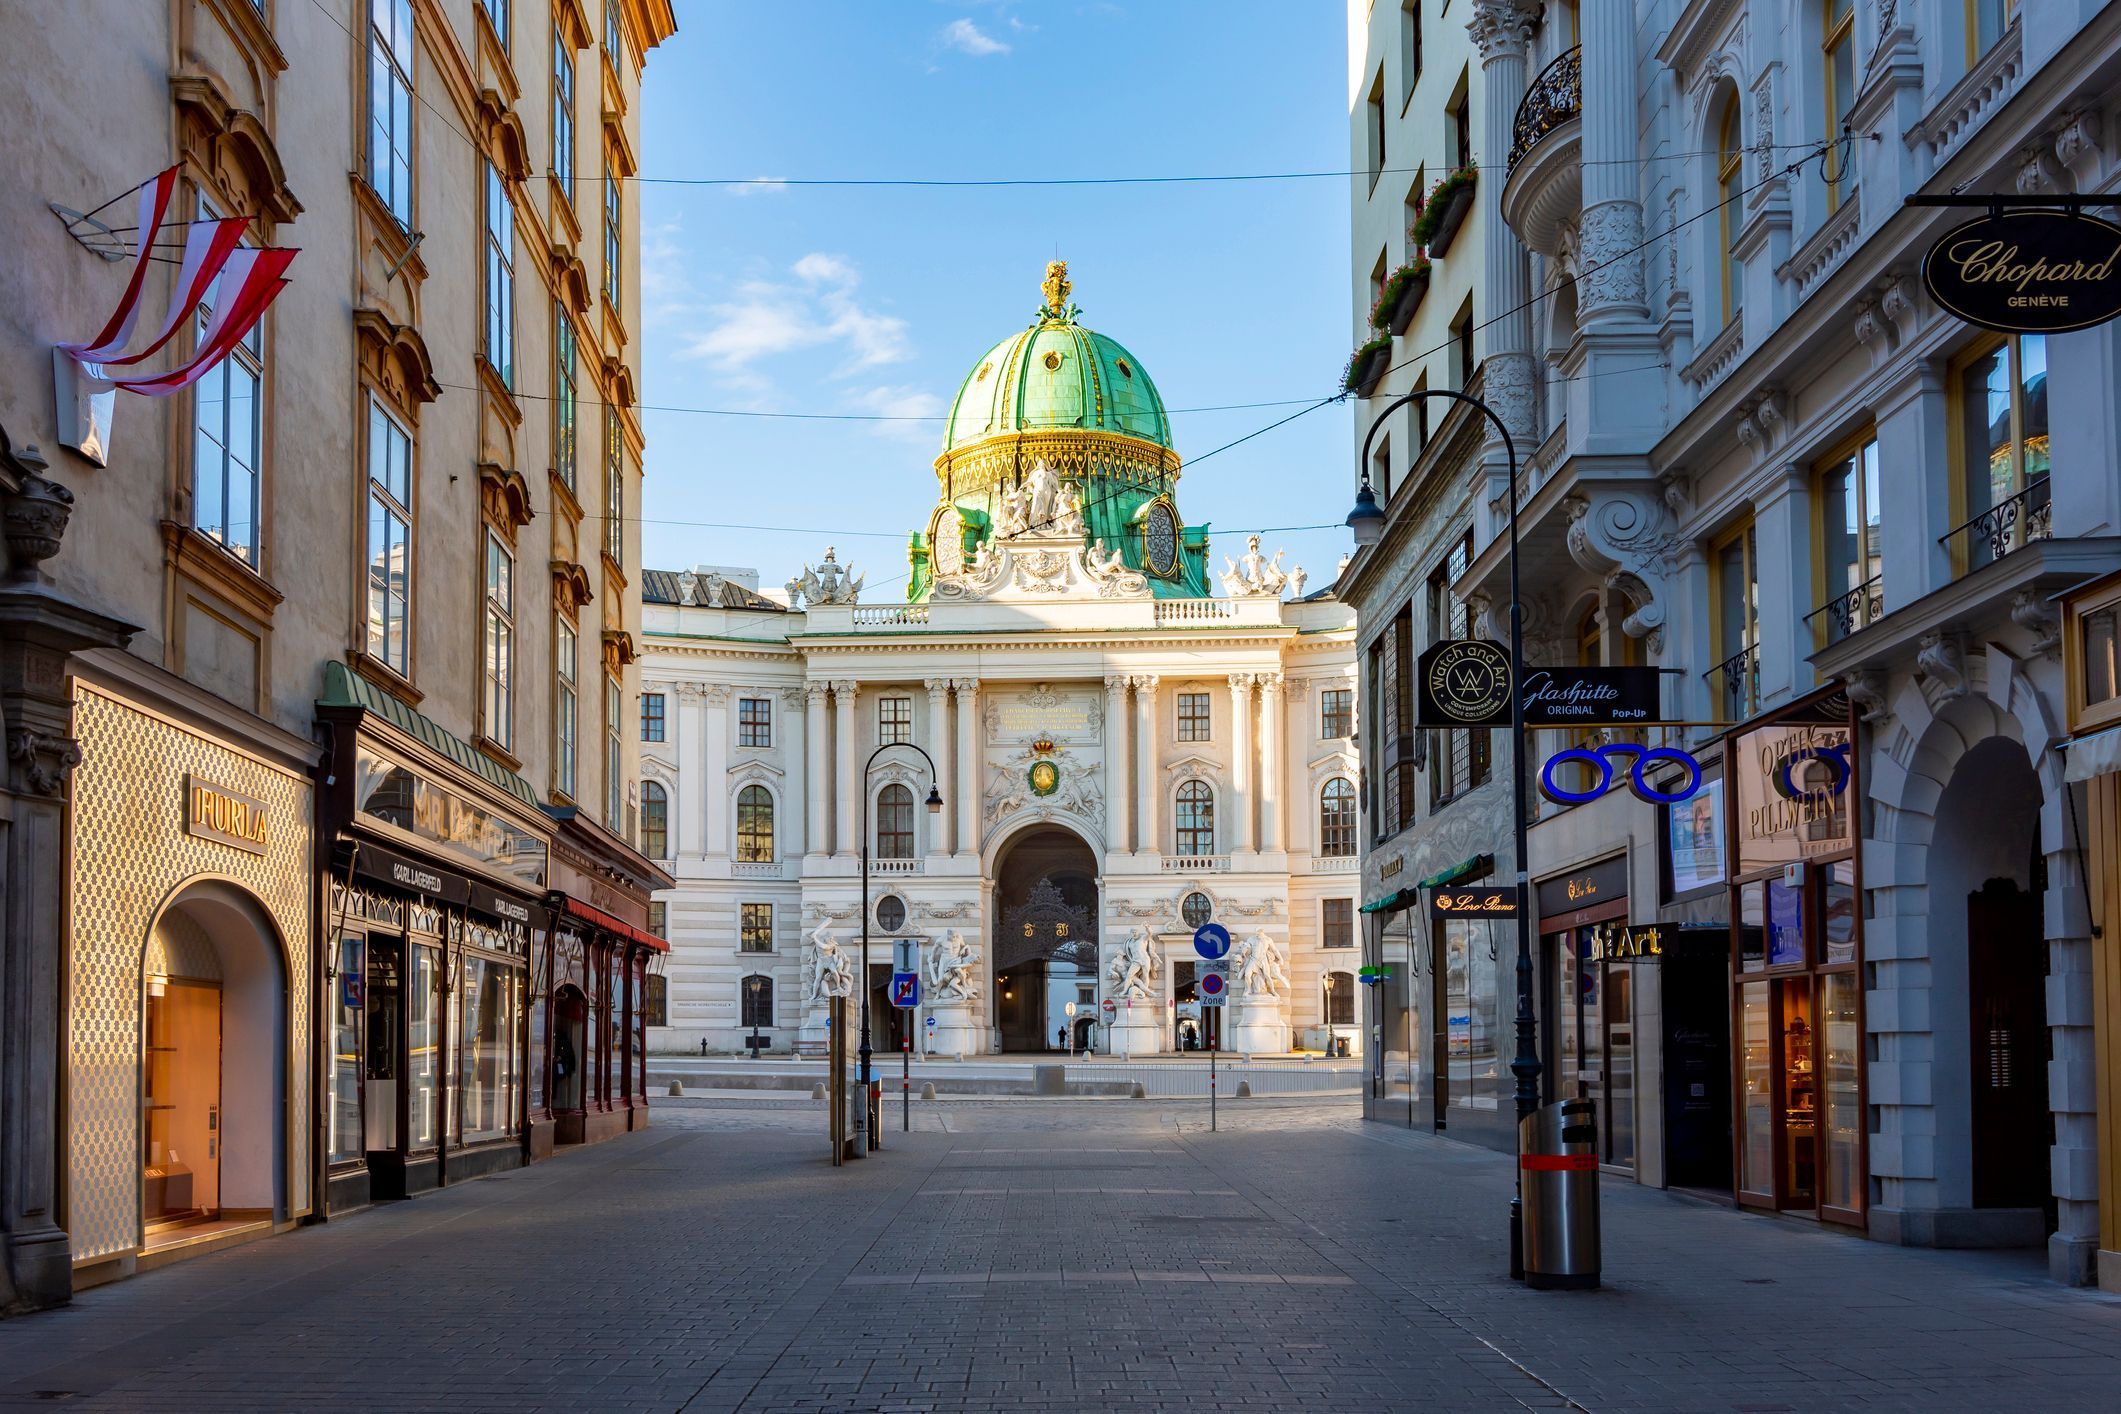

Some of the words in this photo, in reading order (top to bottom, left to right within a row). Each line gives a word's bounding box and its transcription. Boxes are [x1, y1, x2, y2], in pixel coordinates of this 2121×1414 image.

[1949, 240, 2121, 292] Chopard
[2007, 293, 2069, 307] GENÈVE
[1432, 648, 1464, 690] Watch
[1467, 646, 1499, 665] and
[1493, 666, 1507, 688] Art
[1522, 671, 1619, 711] Glashütte
[1547, 705, 1595, 715] ORIGINAL
[1761, 724, 1818, 776] OPTIK
[195, 786, 269, 846] FURLA
[1750, 782, 1837, 840] PILLWEIN
[393, 863, 410, 883] KARL
[410, 868, 441, 892] LAGERFELD
[1452, 895, 1483, 911] Loro
[1483, 894, 1517, 911] Piana
[1616, 927, 1663, 957] Art
[1203, 996, 1223, 1005] Zone
